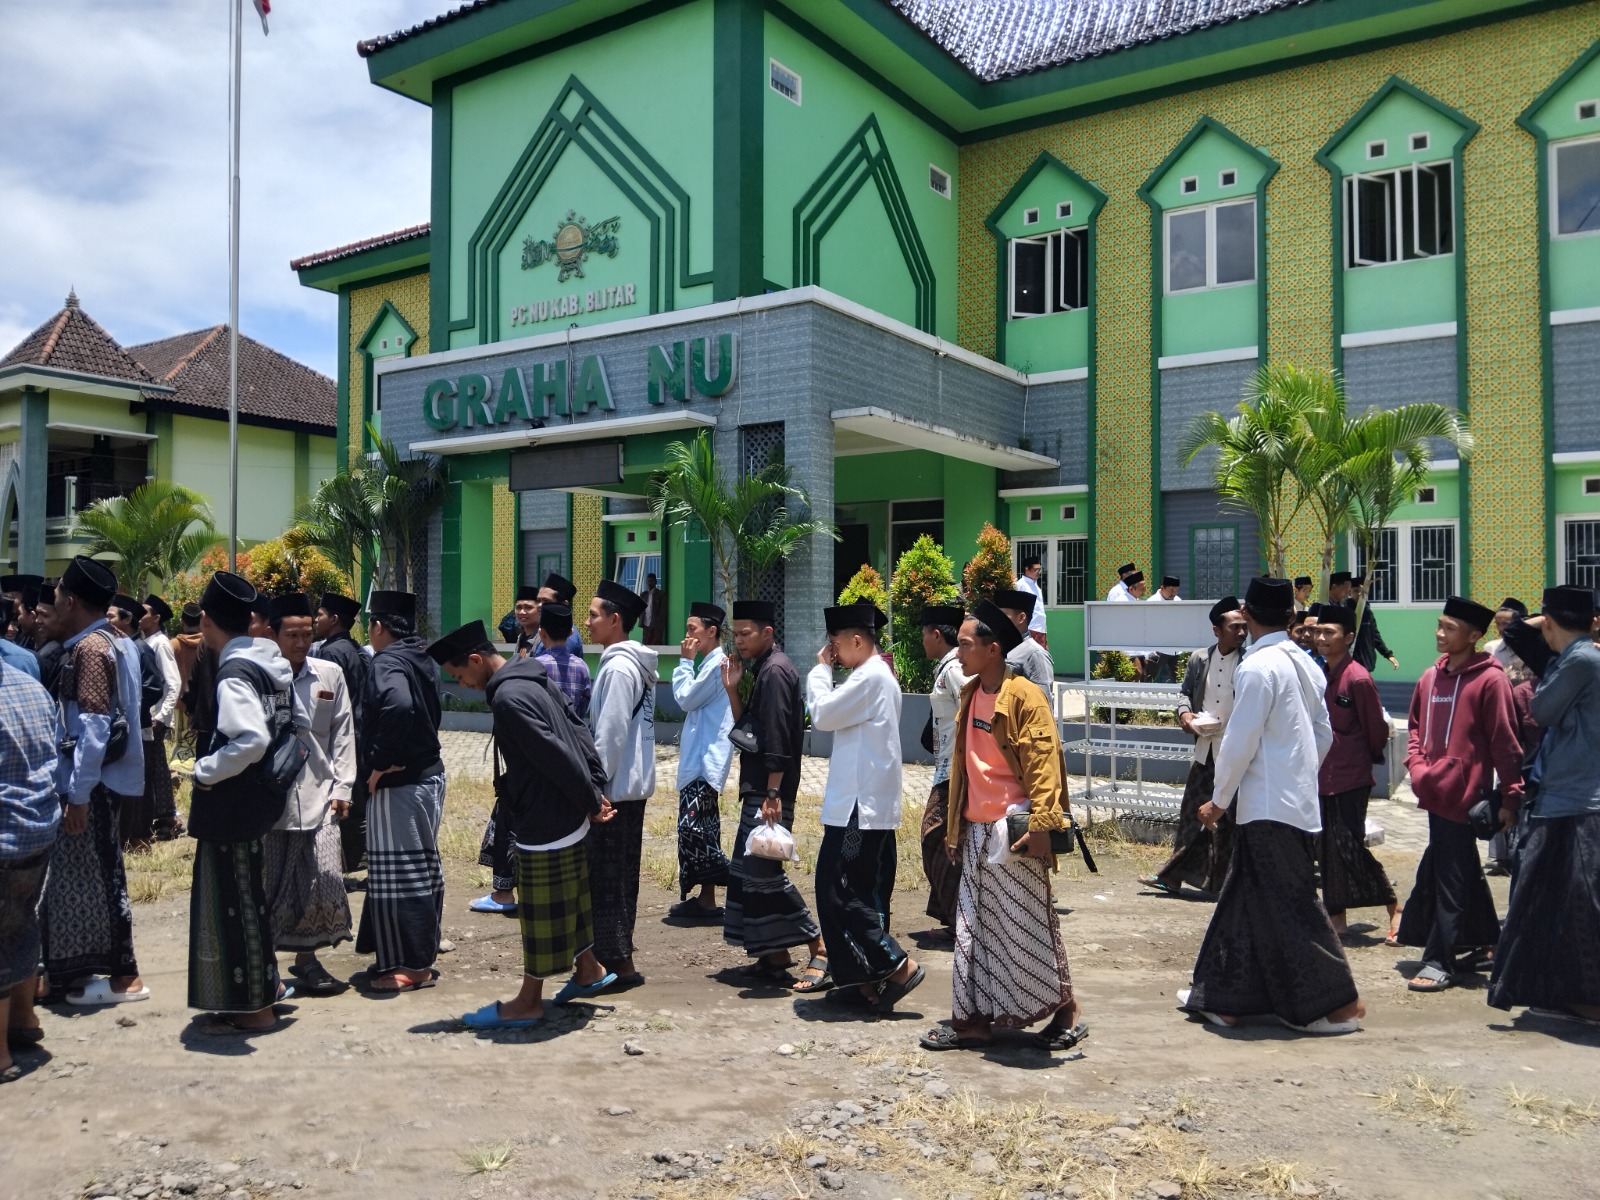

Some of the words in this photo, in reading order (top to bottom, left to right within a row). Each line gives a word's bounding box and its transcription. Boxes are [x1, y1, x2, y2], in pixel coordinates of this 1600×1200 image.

[511, 306, 528, 327] PC
[529, 300, 548, 323] NU
[550, 294, 583, 319] KAB.
[586, 283, 636, 312] BLITAR
[424, 355, 615, 431] GRAHA
[649, 334, 737, 404] NU
